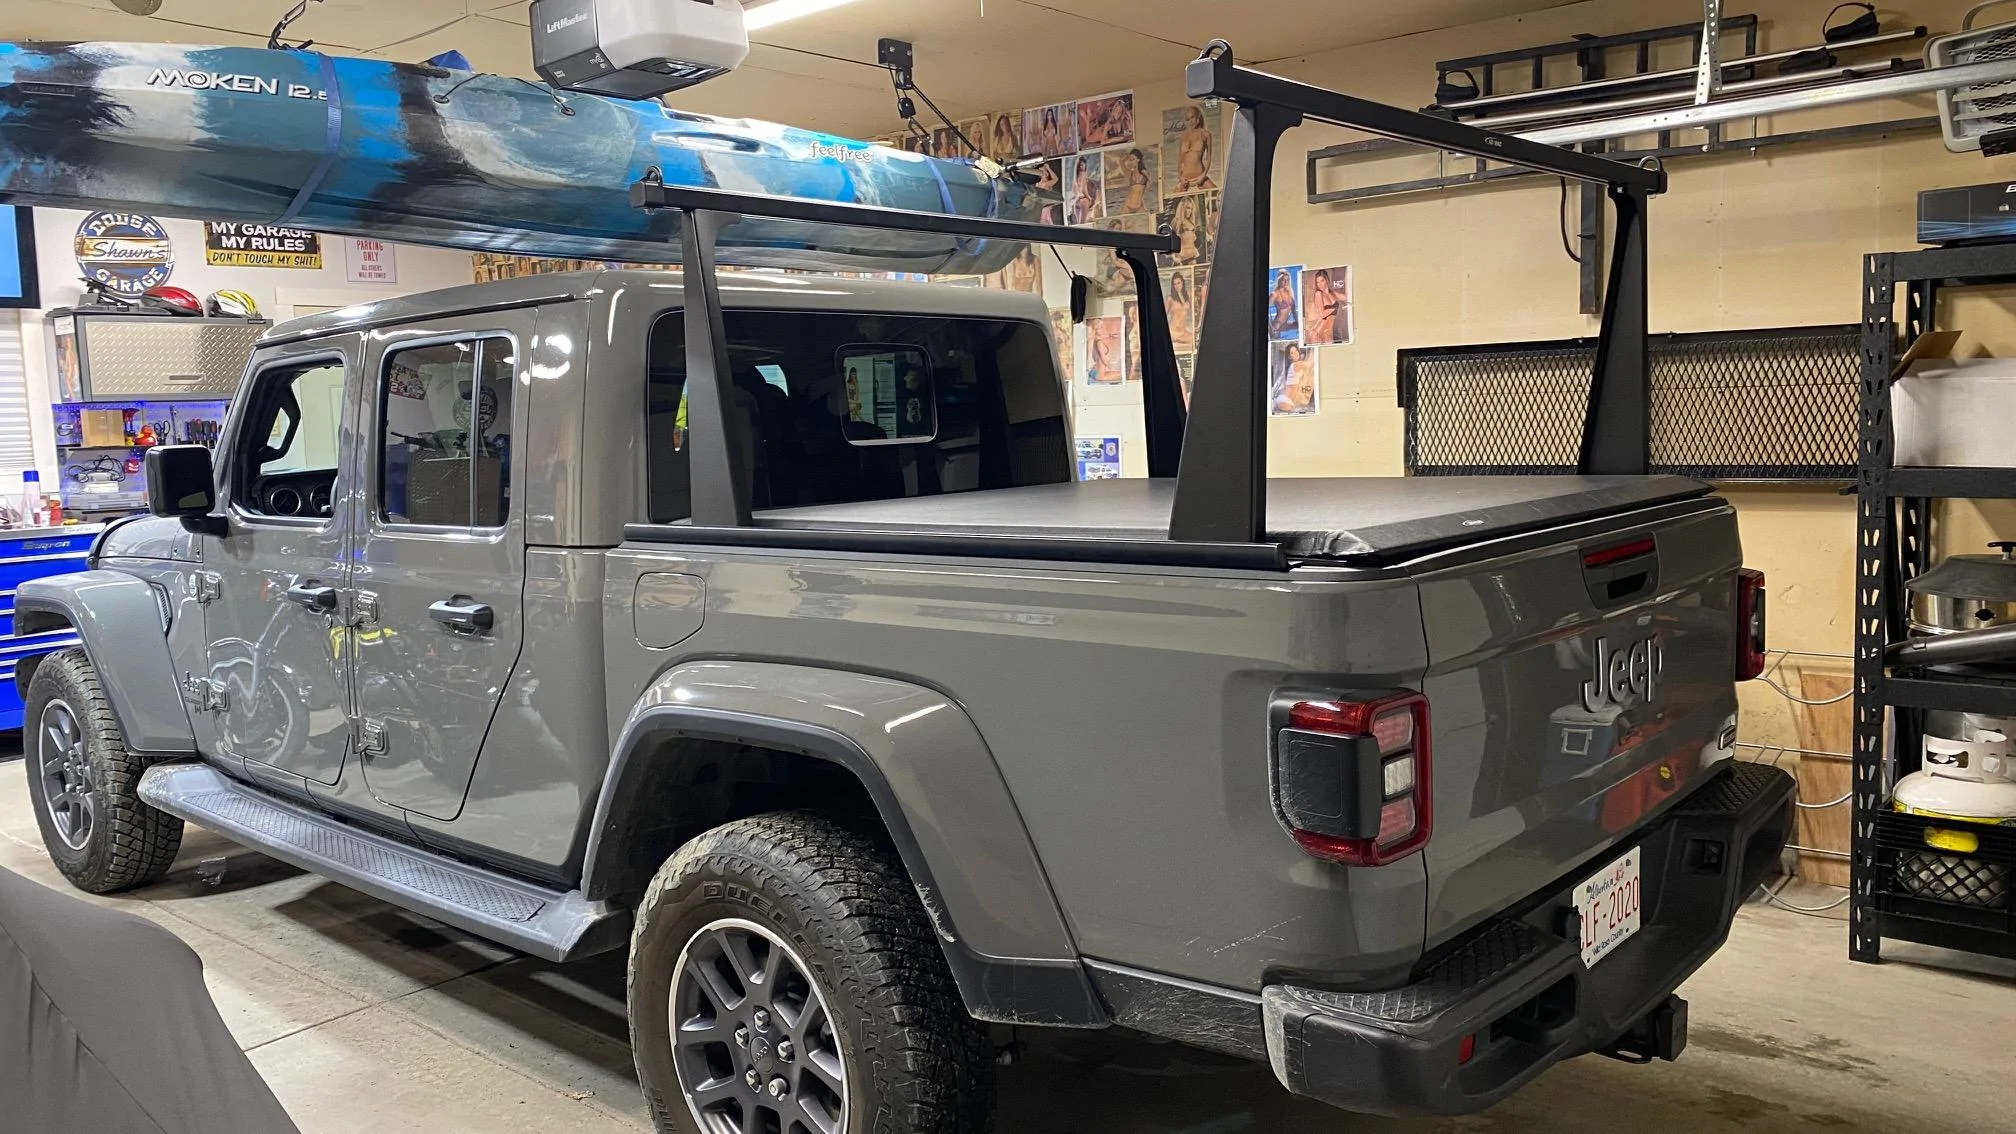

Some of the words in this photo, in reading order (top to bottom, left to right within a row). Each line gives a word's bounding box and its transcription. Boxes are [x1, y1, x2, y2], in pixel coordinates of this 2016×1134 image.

[546, 13, 588, 34] LiftMaster
[147, 68, 279, 95] MOKEN
[810, 141, 872, 162] feelfree
[211, 221, 237, 235] MY
[221, 236, 248, 249] MY
[251, 238, 306, 251] RULES
[356, 239, 384, 251] PARKING
[212, 252, 242, 263] DON'T
[244, 253, 274, 264] TOUCH
[277, 255, 292, 264] MY
[294, 255, 317, 266] SHIT!
[363, 251, 379, 262] ONLY
[96, 267, 164, 292] GARAGE
[1582, 636, 1664, 714] Jeep
